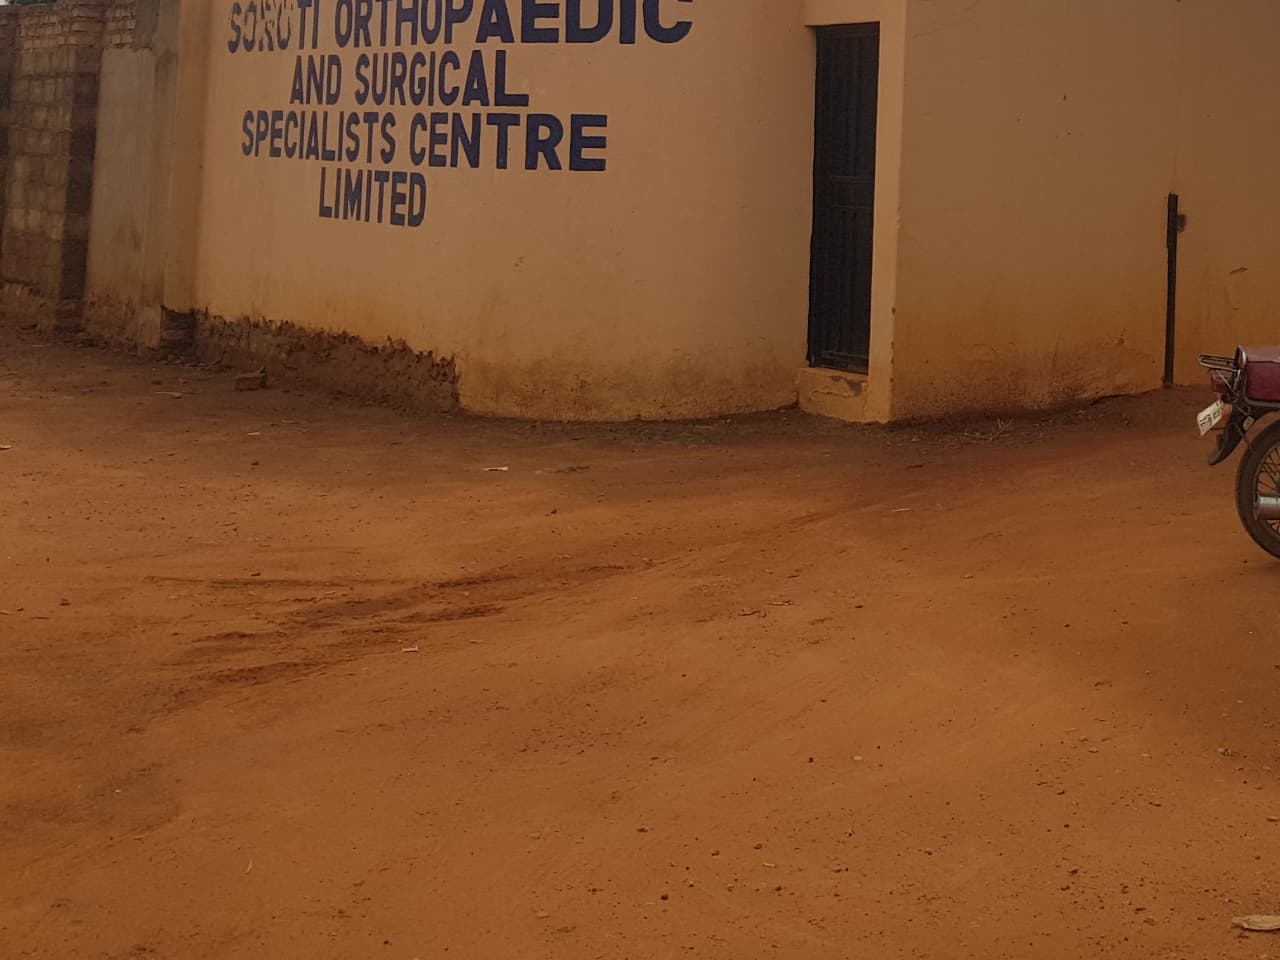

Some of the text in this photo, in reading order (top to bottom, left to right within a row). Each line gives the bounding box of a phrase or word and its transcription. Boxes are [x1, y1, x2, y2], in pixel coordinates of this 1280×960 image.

[289, 50, 529, 107] AND SURGICAL
[242, 110, 608, 172] SPECIALISTS CENTRE
[319, 167, 427, 228] LIMITED
